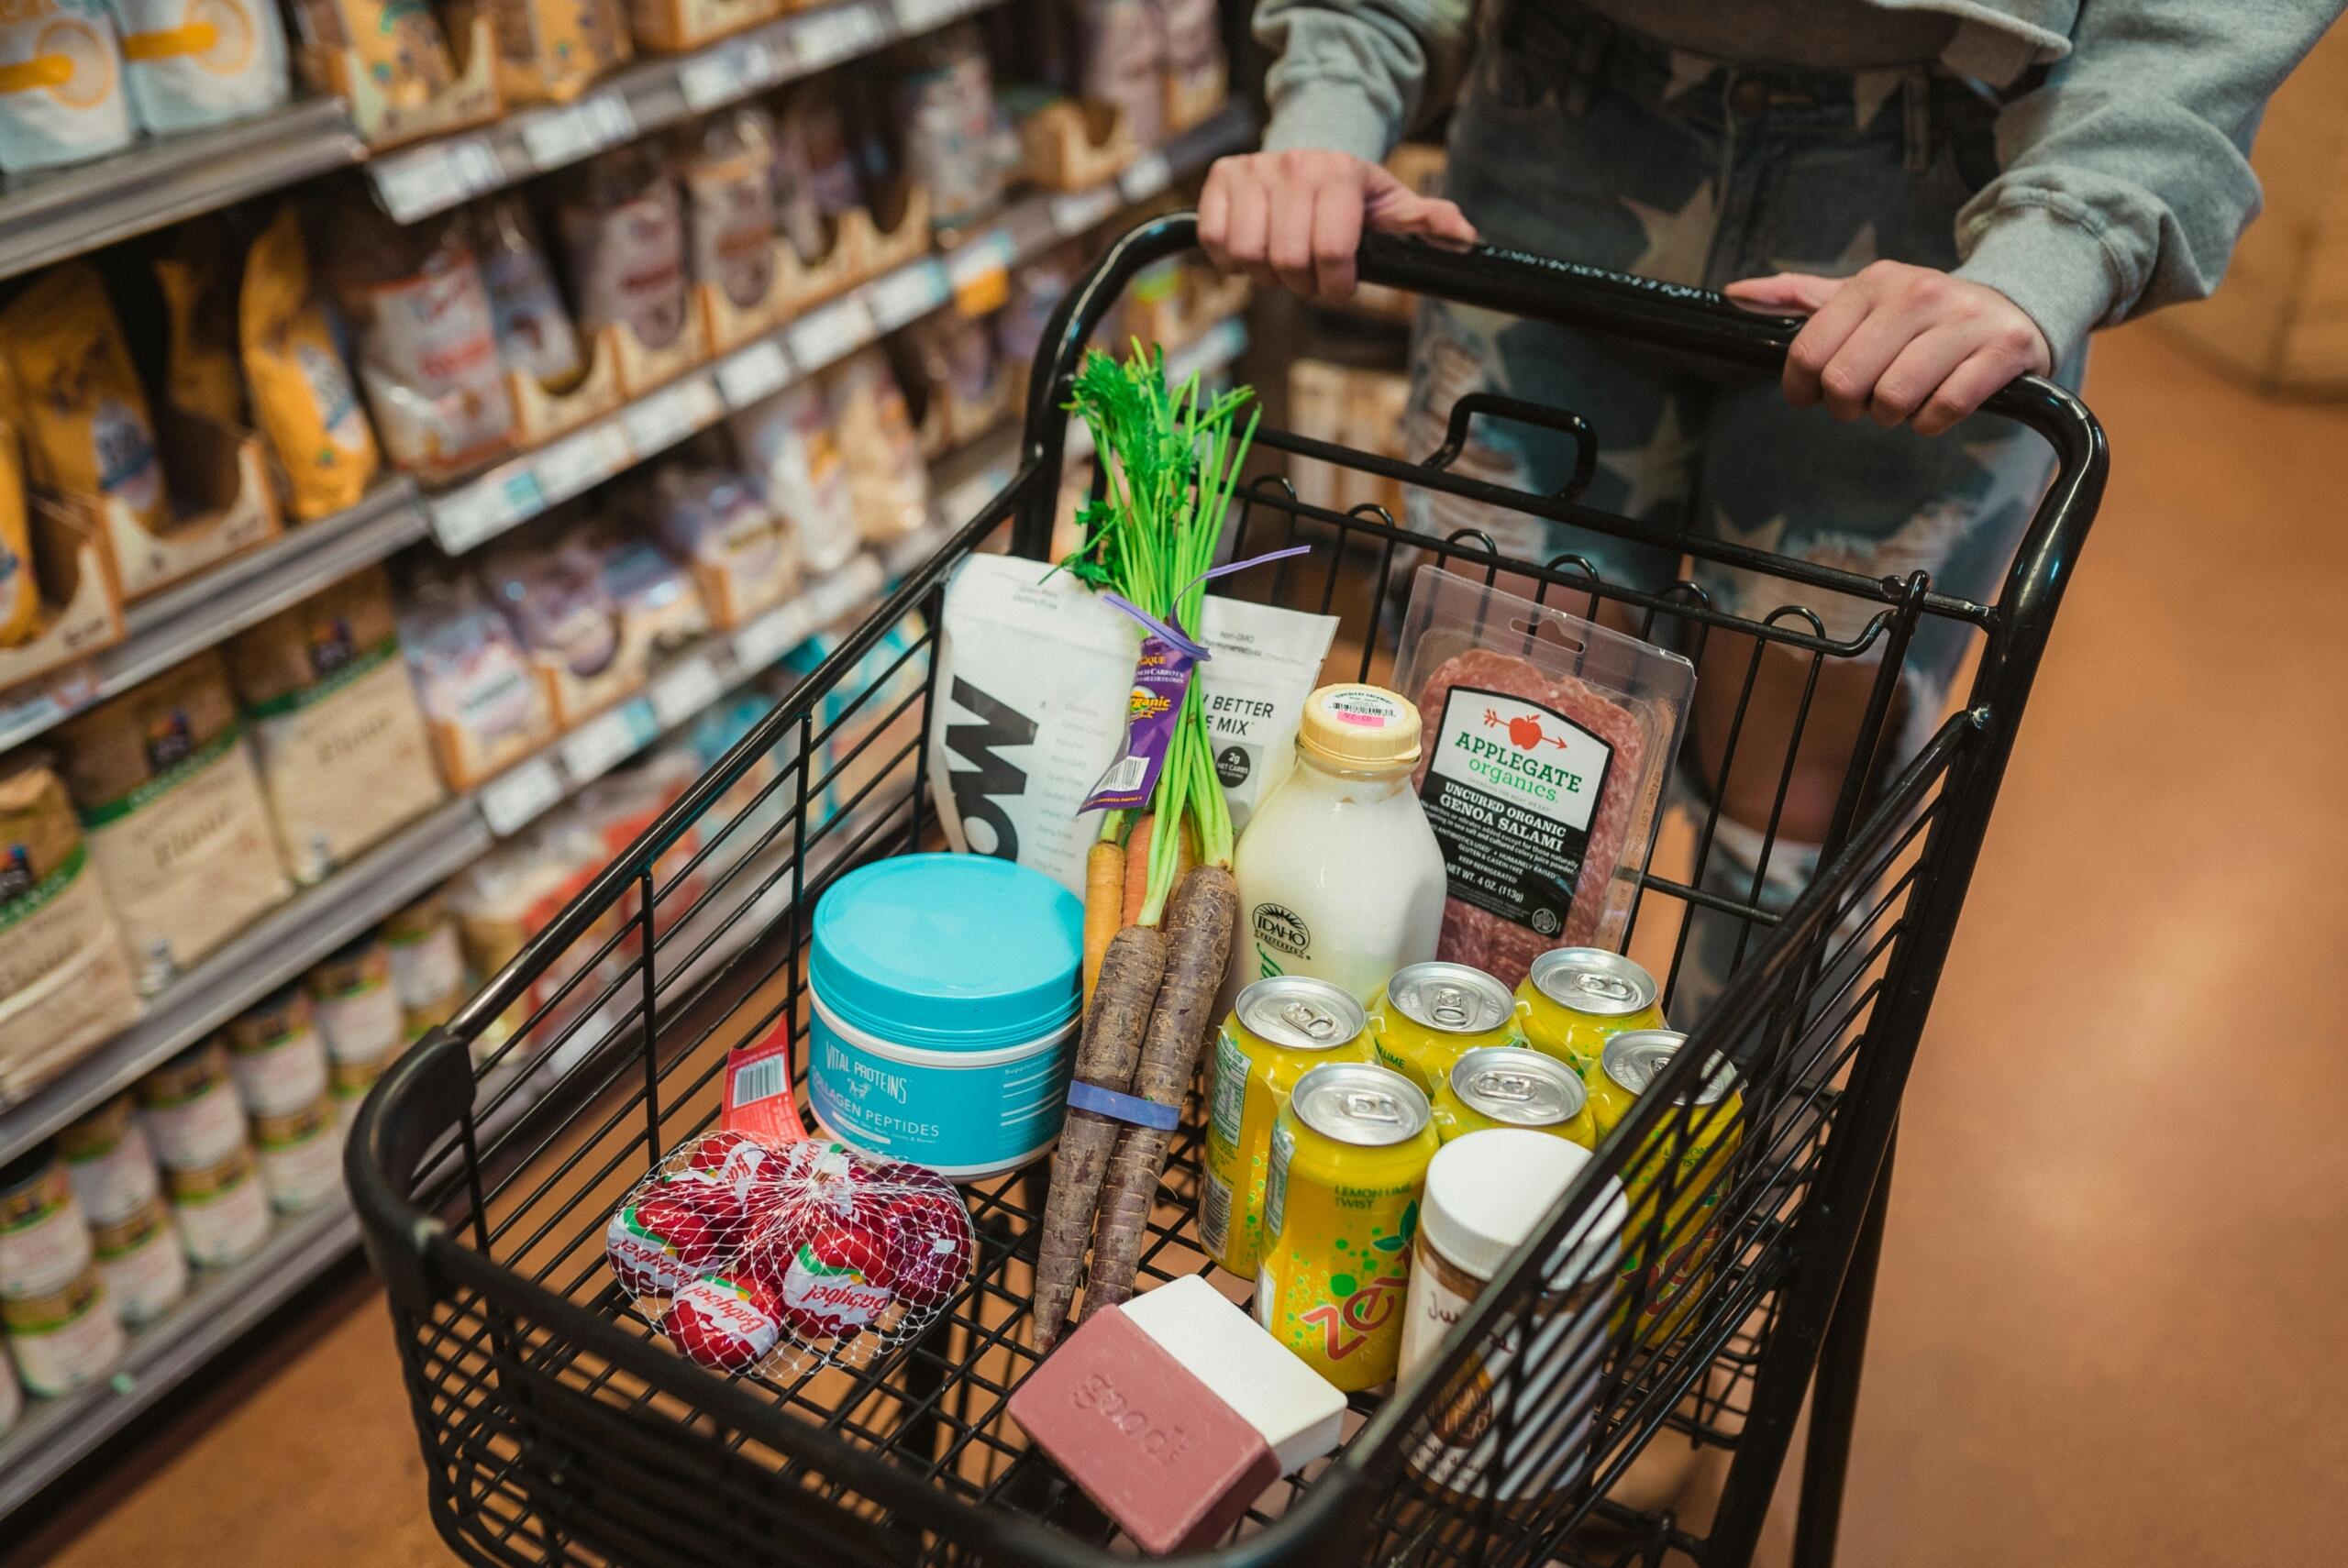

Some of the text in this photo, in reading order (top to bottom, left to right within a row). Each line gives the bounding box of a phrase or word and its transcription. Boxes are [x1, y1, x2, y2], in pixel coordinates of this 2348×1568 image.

[1129, 696, 1170, 708] rganic
[1212, 695, 1274, 718] BETTER
[1216, 716, 1249, 735] MIX
[946, 675, 1038, 862] OW
[1228, 752, 1240, 765] 2g
[1454, 731, 1584, 793] APPLEGATE
[1466, 757, 1558, 806] organics
[1437, 793, 1564, 852] GENOA SALAMI
[1443, 781, 1567, 838] UNCURED ORGANIC
[1428, 803, 1451, 817] nitrites
[1457, 816, 1482, 830] nitrates
[1482, 825, 1501, 838] added
[1501, 834, 1523, 847] except
[1522, 842, 1533, 850] for
[1532, 845, 1547, 856] those
[1545, 852, 1578, 869] naturally
[1437, 826, 1475, 845] ANTIBIOTICS
[1498, 853, 1533, 870] HUMANELY
[1454, 823, 1465, 831] sea
[1465, 826, 1477, 835] salt
[1477, 832, 1490, 841] and
[1489, 835, 1516, 851] cultured
[1514, 846, 1534, 859] celery
[1534, 854, 1550, 866] juice
[1457, 844, 1483, 858] GLUTEN
[1486, 856, 1510, 869] CASEIN
[1509, 865, 1523, 875] FREE
[1458, 856, 1518, 884] KEEP REFRIGERATED
[1445, 862, 1524, 902] NET WT. 4 OZ. (113g)
[1257, 915, 1306, 946] IDAHO
[825, 1040, 907, 1104] VITAL PROTEINS
[1382, 1050, 1405, 1069] LIME
[865, 1110, 939, 1137] PEPTIDES
[1335, 1182, 1412, 1198] LEMON LIME
[1335, 1197, 1374, 1209] TWIST
[683, 1286, 767, 1336] Babybel
[801, 1284, 889, 1320] Babybel
